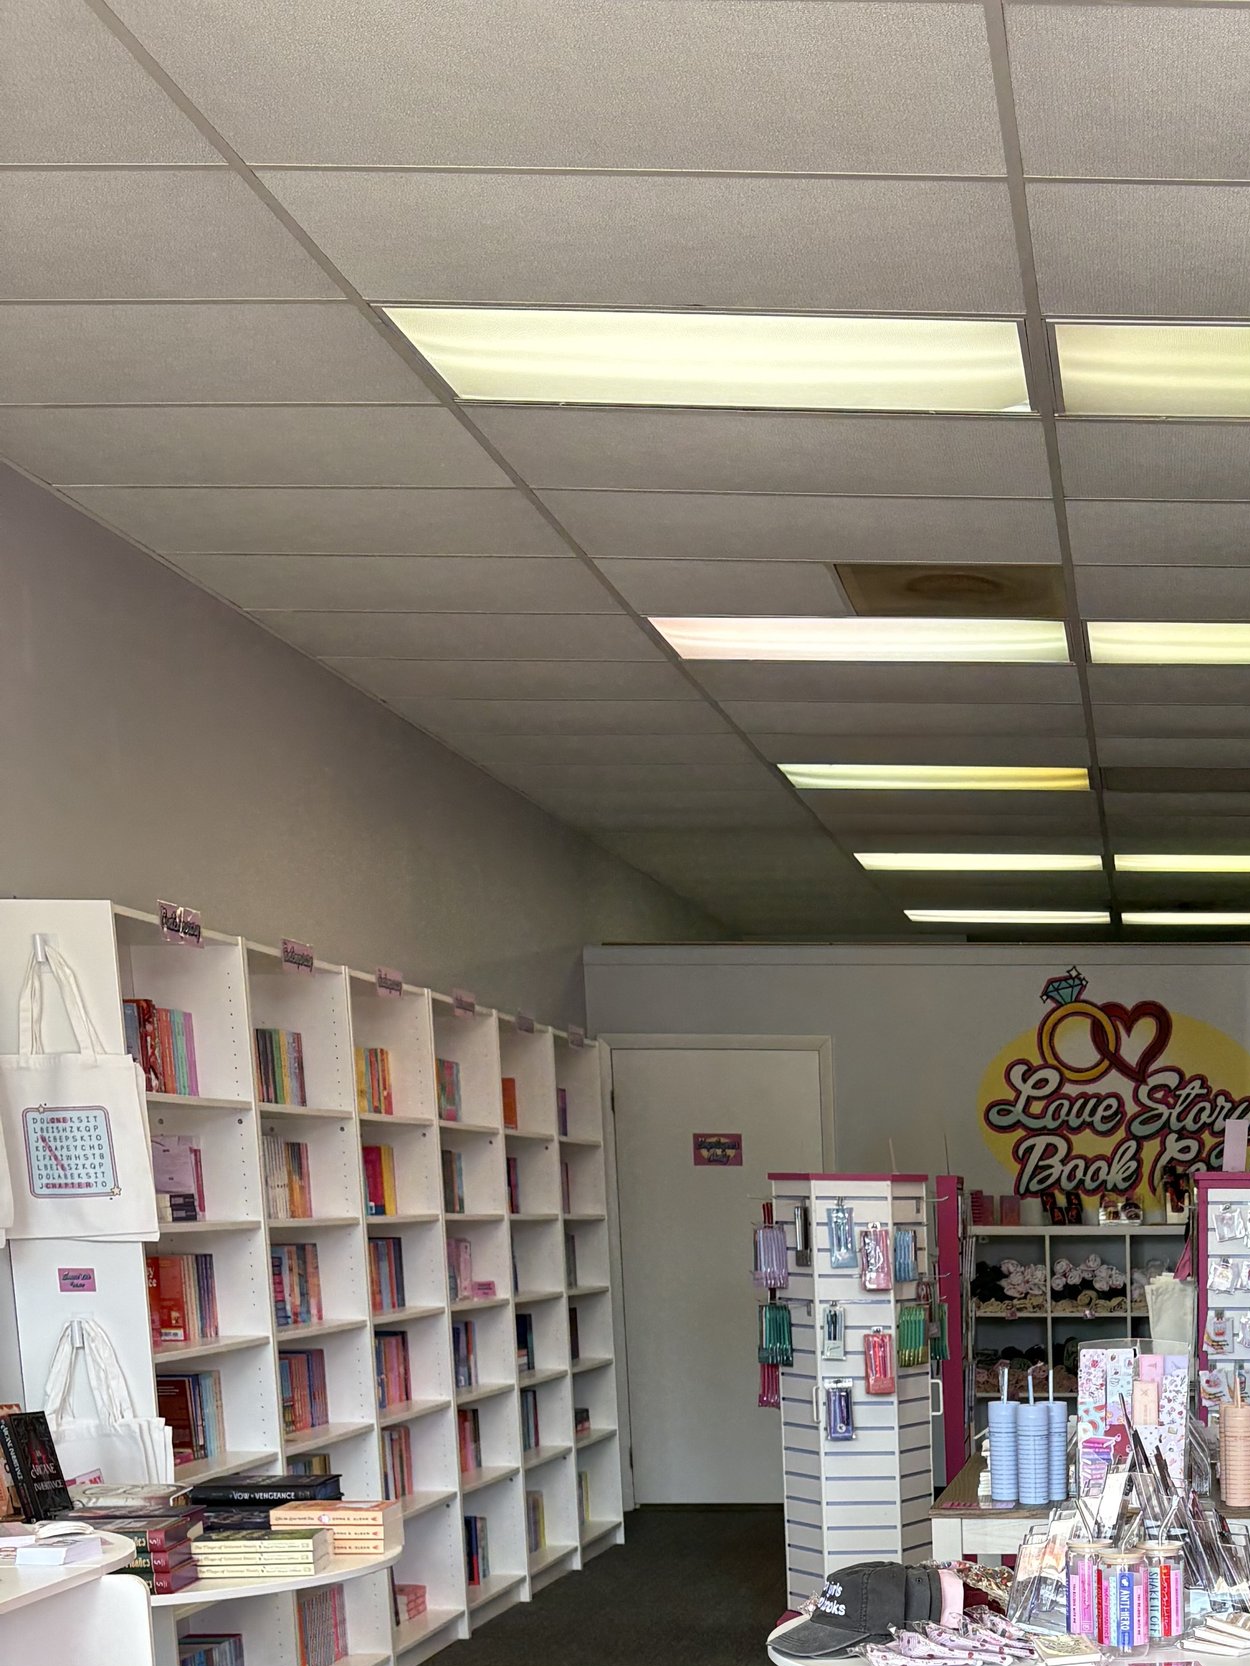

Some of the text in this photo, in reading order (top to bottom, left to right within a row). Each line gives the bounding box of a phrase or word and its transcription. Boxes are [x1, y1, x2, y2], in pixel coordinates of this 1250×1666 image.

[986, 1060, 1124, 1134] Love
[1016, 1133, 1139, 1194] Book
[233, 1491, 295, 1500] VOW VENGEANCE
[1120, 1589, 1131, 1632] ANTI-HERO
[1148, 1571, 1160, 1635] SHAKE IT OFF
